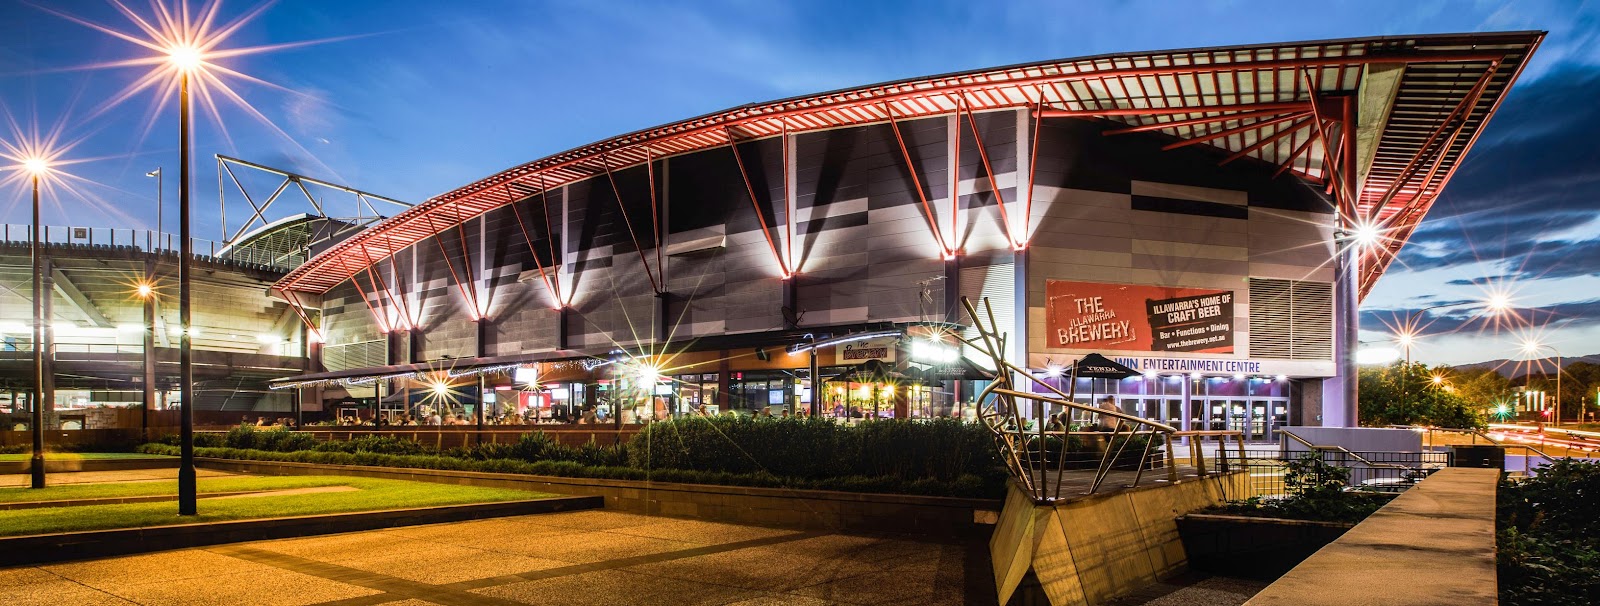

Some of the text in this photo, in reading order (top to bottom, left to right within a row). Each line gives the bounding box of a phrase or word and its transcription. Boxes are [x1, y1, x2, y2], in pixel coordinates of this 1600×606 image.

[1074, 296, 1105, 314] THE
[1153, 294, 1231, 315] ILLAWARRA'S HOME OF
[1069, 309, 1116, 328] ILLAWARRA
[1167, 305, 1221, 324] CRAFT BEER
[1057, 319, 1131, 345] BREWERY
[1159, 322, 1229, 340] Bar Functions Dining
[1166, 335, 1226, 349] www.thebrewery.net.au
[1114, 357, 1260, 373] WIN ENTERTAINMENT CENTRE
